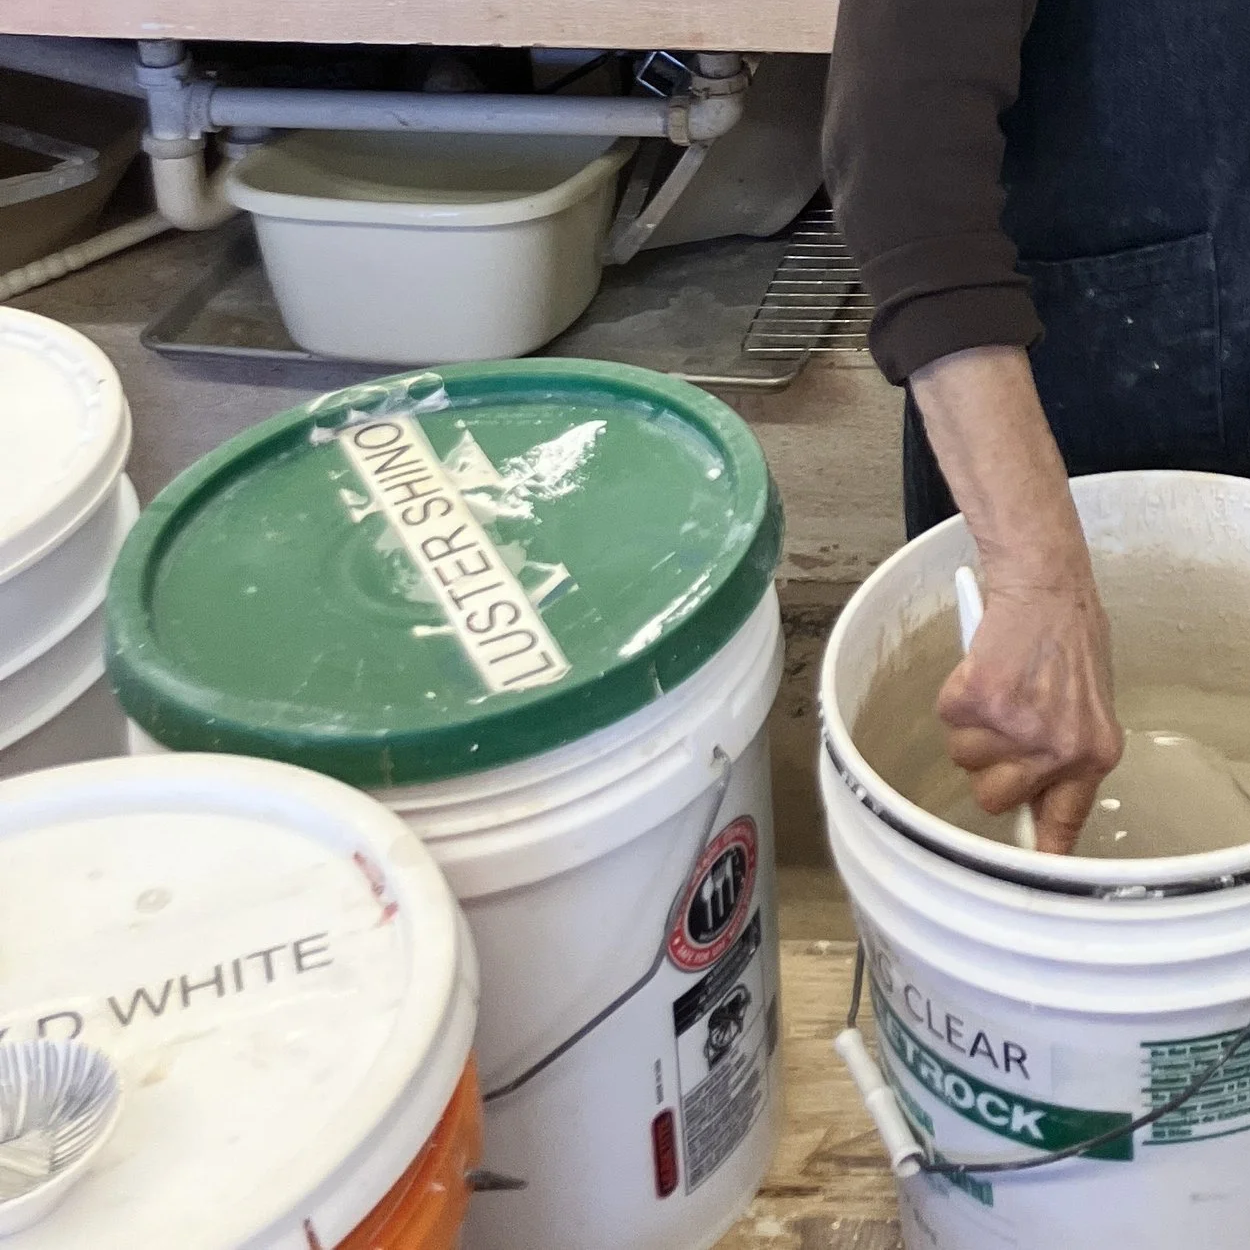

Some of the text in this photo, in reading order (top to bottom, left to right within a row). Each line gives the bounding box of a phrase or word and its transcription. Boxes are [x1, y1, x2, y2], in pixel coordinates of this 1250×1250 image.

[353, 421, 556, 687] LUSTER SHINO
[107, 930, 335, 1028] WHITE
[903, 982, 1031, 1081] CLEAR
